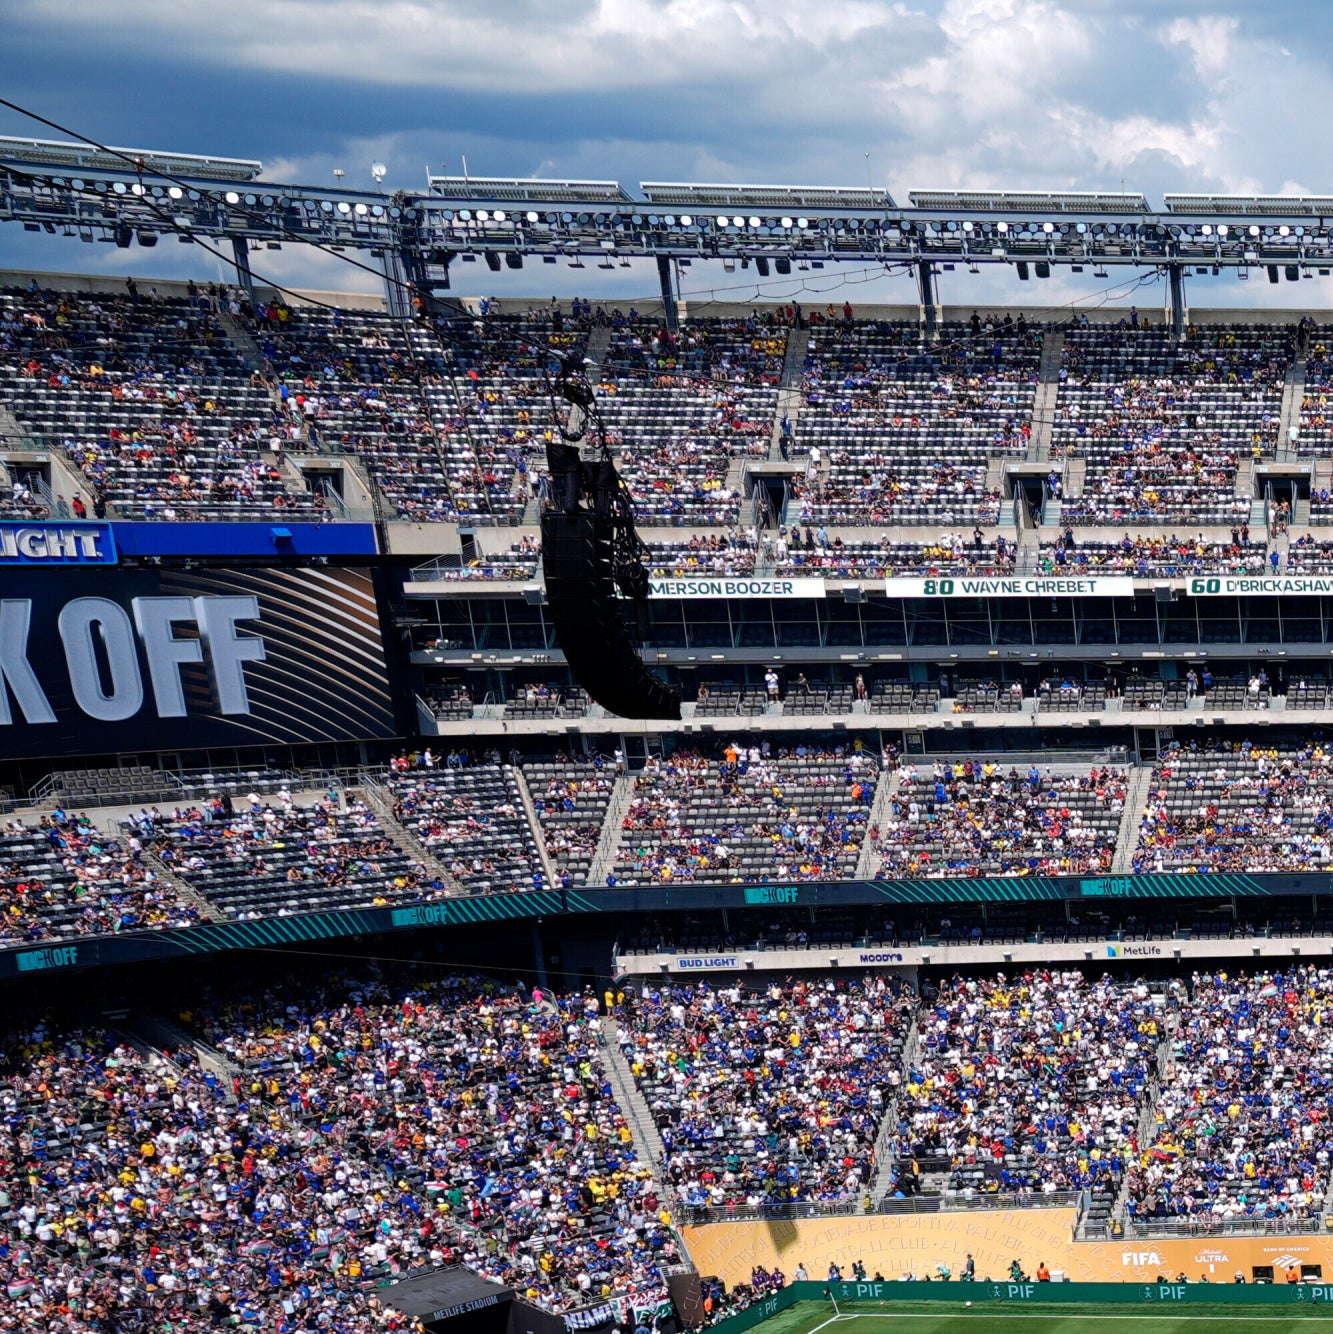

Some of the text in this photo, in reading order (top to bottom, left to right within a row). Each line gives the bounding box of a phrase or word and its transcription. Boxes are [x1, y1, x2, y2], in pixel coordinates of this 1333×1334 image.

[649, 581, 793, 596] MERSON BOOZER
[923, 579, 1097, 595] 80 WAYNE CHREBET
[1191, 578, 1221, 594] 60
[57, 595, 266, 721] OFF
[777, 887, 798, 903] OFF
[1111, 878, 1133, 896] OFF
[426, 904, 447, 923] OFF
[860, 953, 903, 963] MOODY'S
[1123, 946, 1161, 956] MetLife
[679, 958, 737, 968] BUD LIGHT
[1122, 1251, 1160, 1267] FIFA
[1195, 1254, 1229, 1263] ULTRA
[857, 1284, 884, 1299] PIF
[1008, 1285, 1035, 1300] PIF
[1160, 1286, 1186, 1300] PIF
[433, 1295, 499, 1321] METLIFE STADIUM
[765, 1297, 779, 1314] PIF
